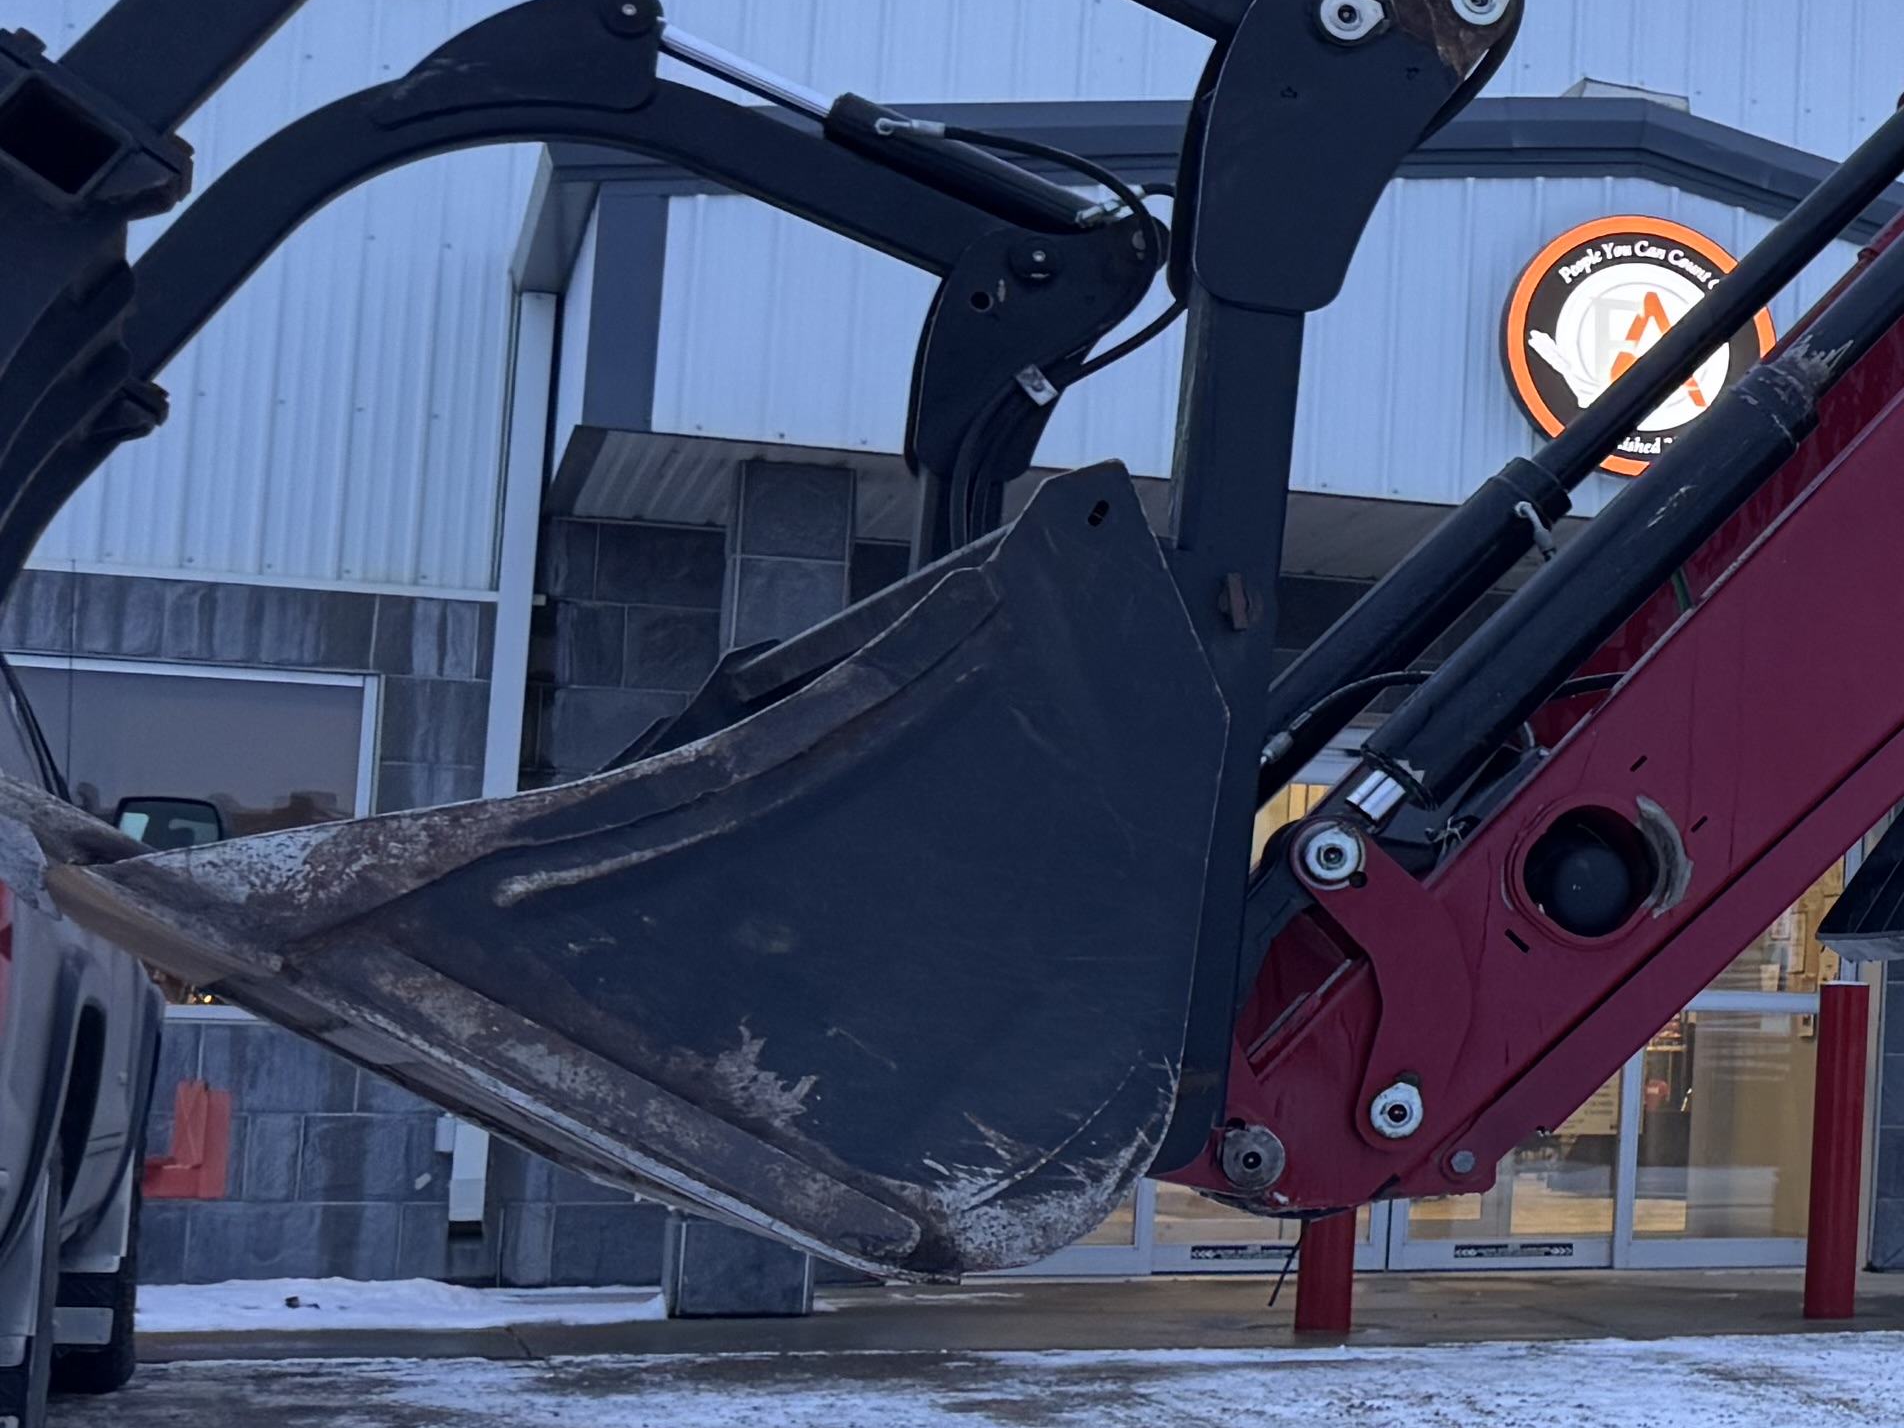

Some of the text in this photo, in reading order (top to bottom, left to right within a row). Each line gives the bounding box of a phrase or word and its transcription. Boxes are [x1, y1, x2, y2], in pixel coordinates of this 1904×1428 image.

[1558, 248, 1603, 284] People
[1601, 242, 1632, 260] You
[1634, 240, 1666, 260] Can
